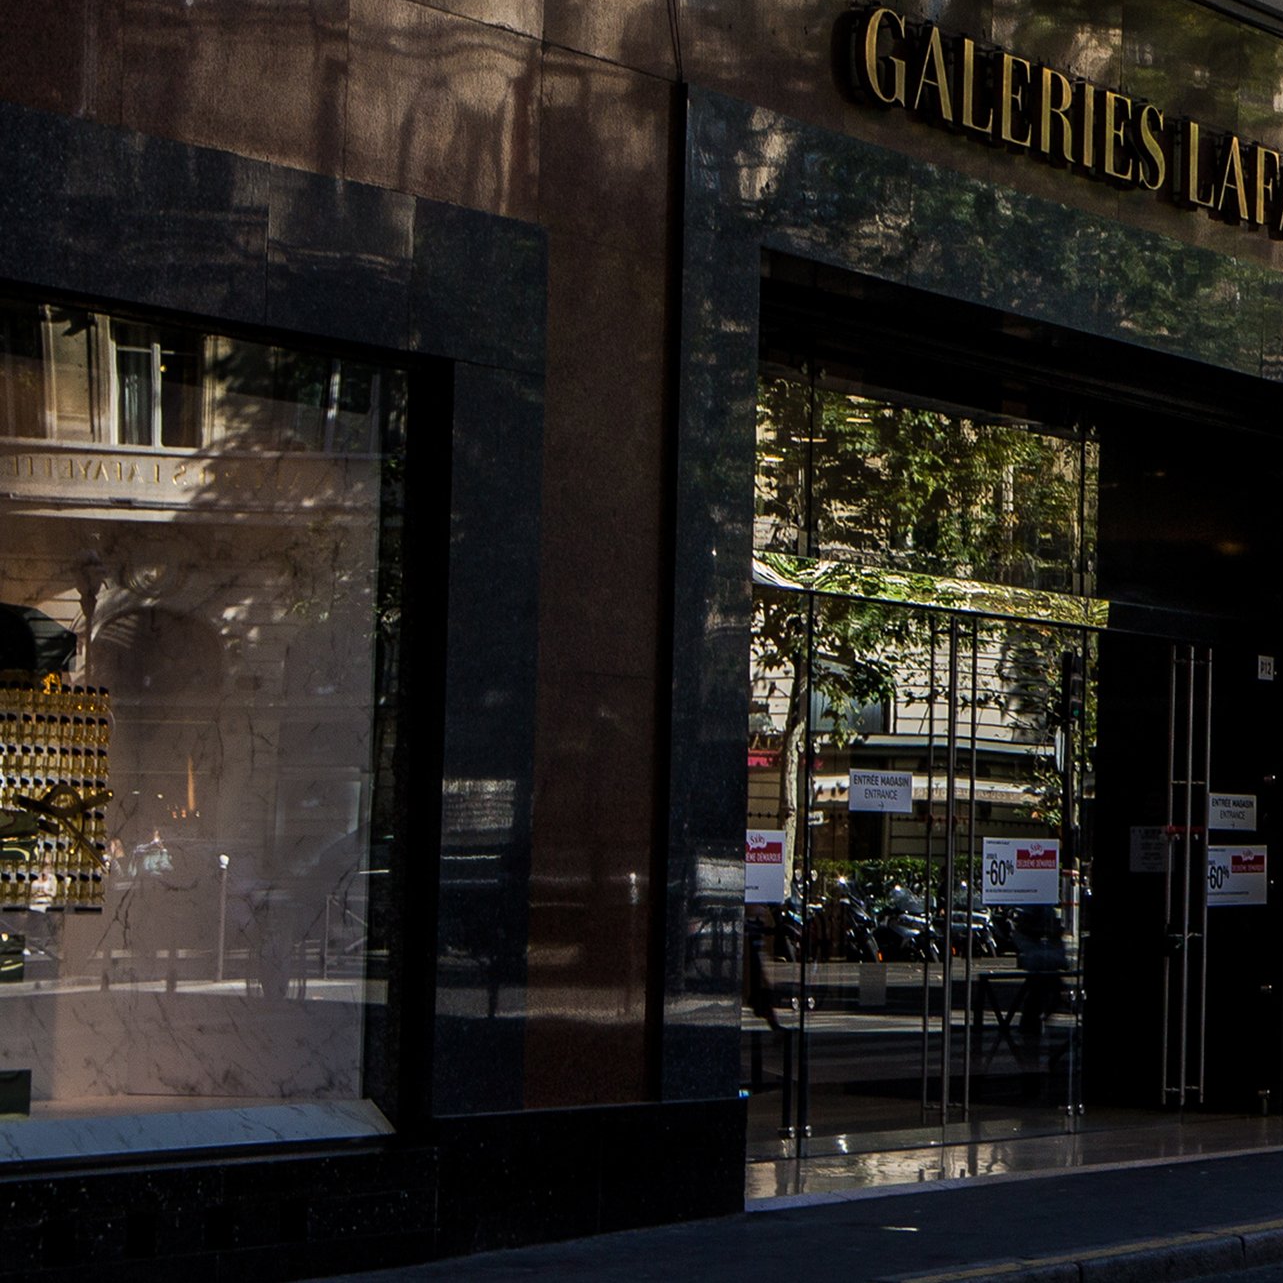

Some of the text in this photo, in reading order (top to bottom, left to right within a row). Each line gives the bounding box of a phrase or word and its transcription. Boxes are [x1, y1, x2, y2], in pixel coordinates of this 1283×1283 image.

[864, 7, 1167, 190] GALERIES
[853, 774, 910, 787] ENTRÉE MAGASIN
[864, 788, 898, 800] ENTRANCE
[986, 859, 1014, 886] -60%
